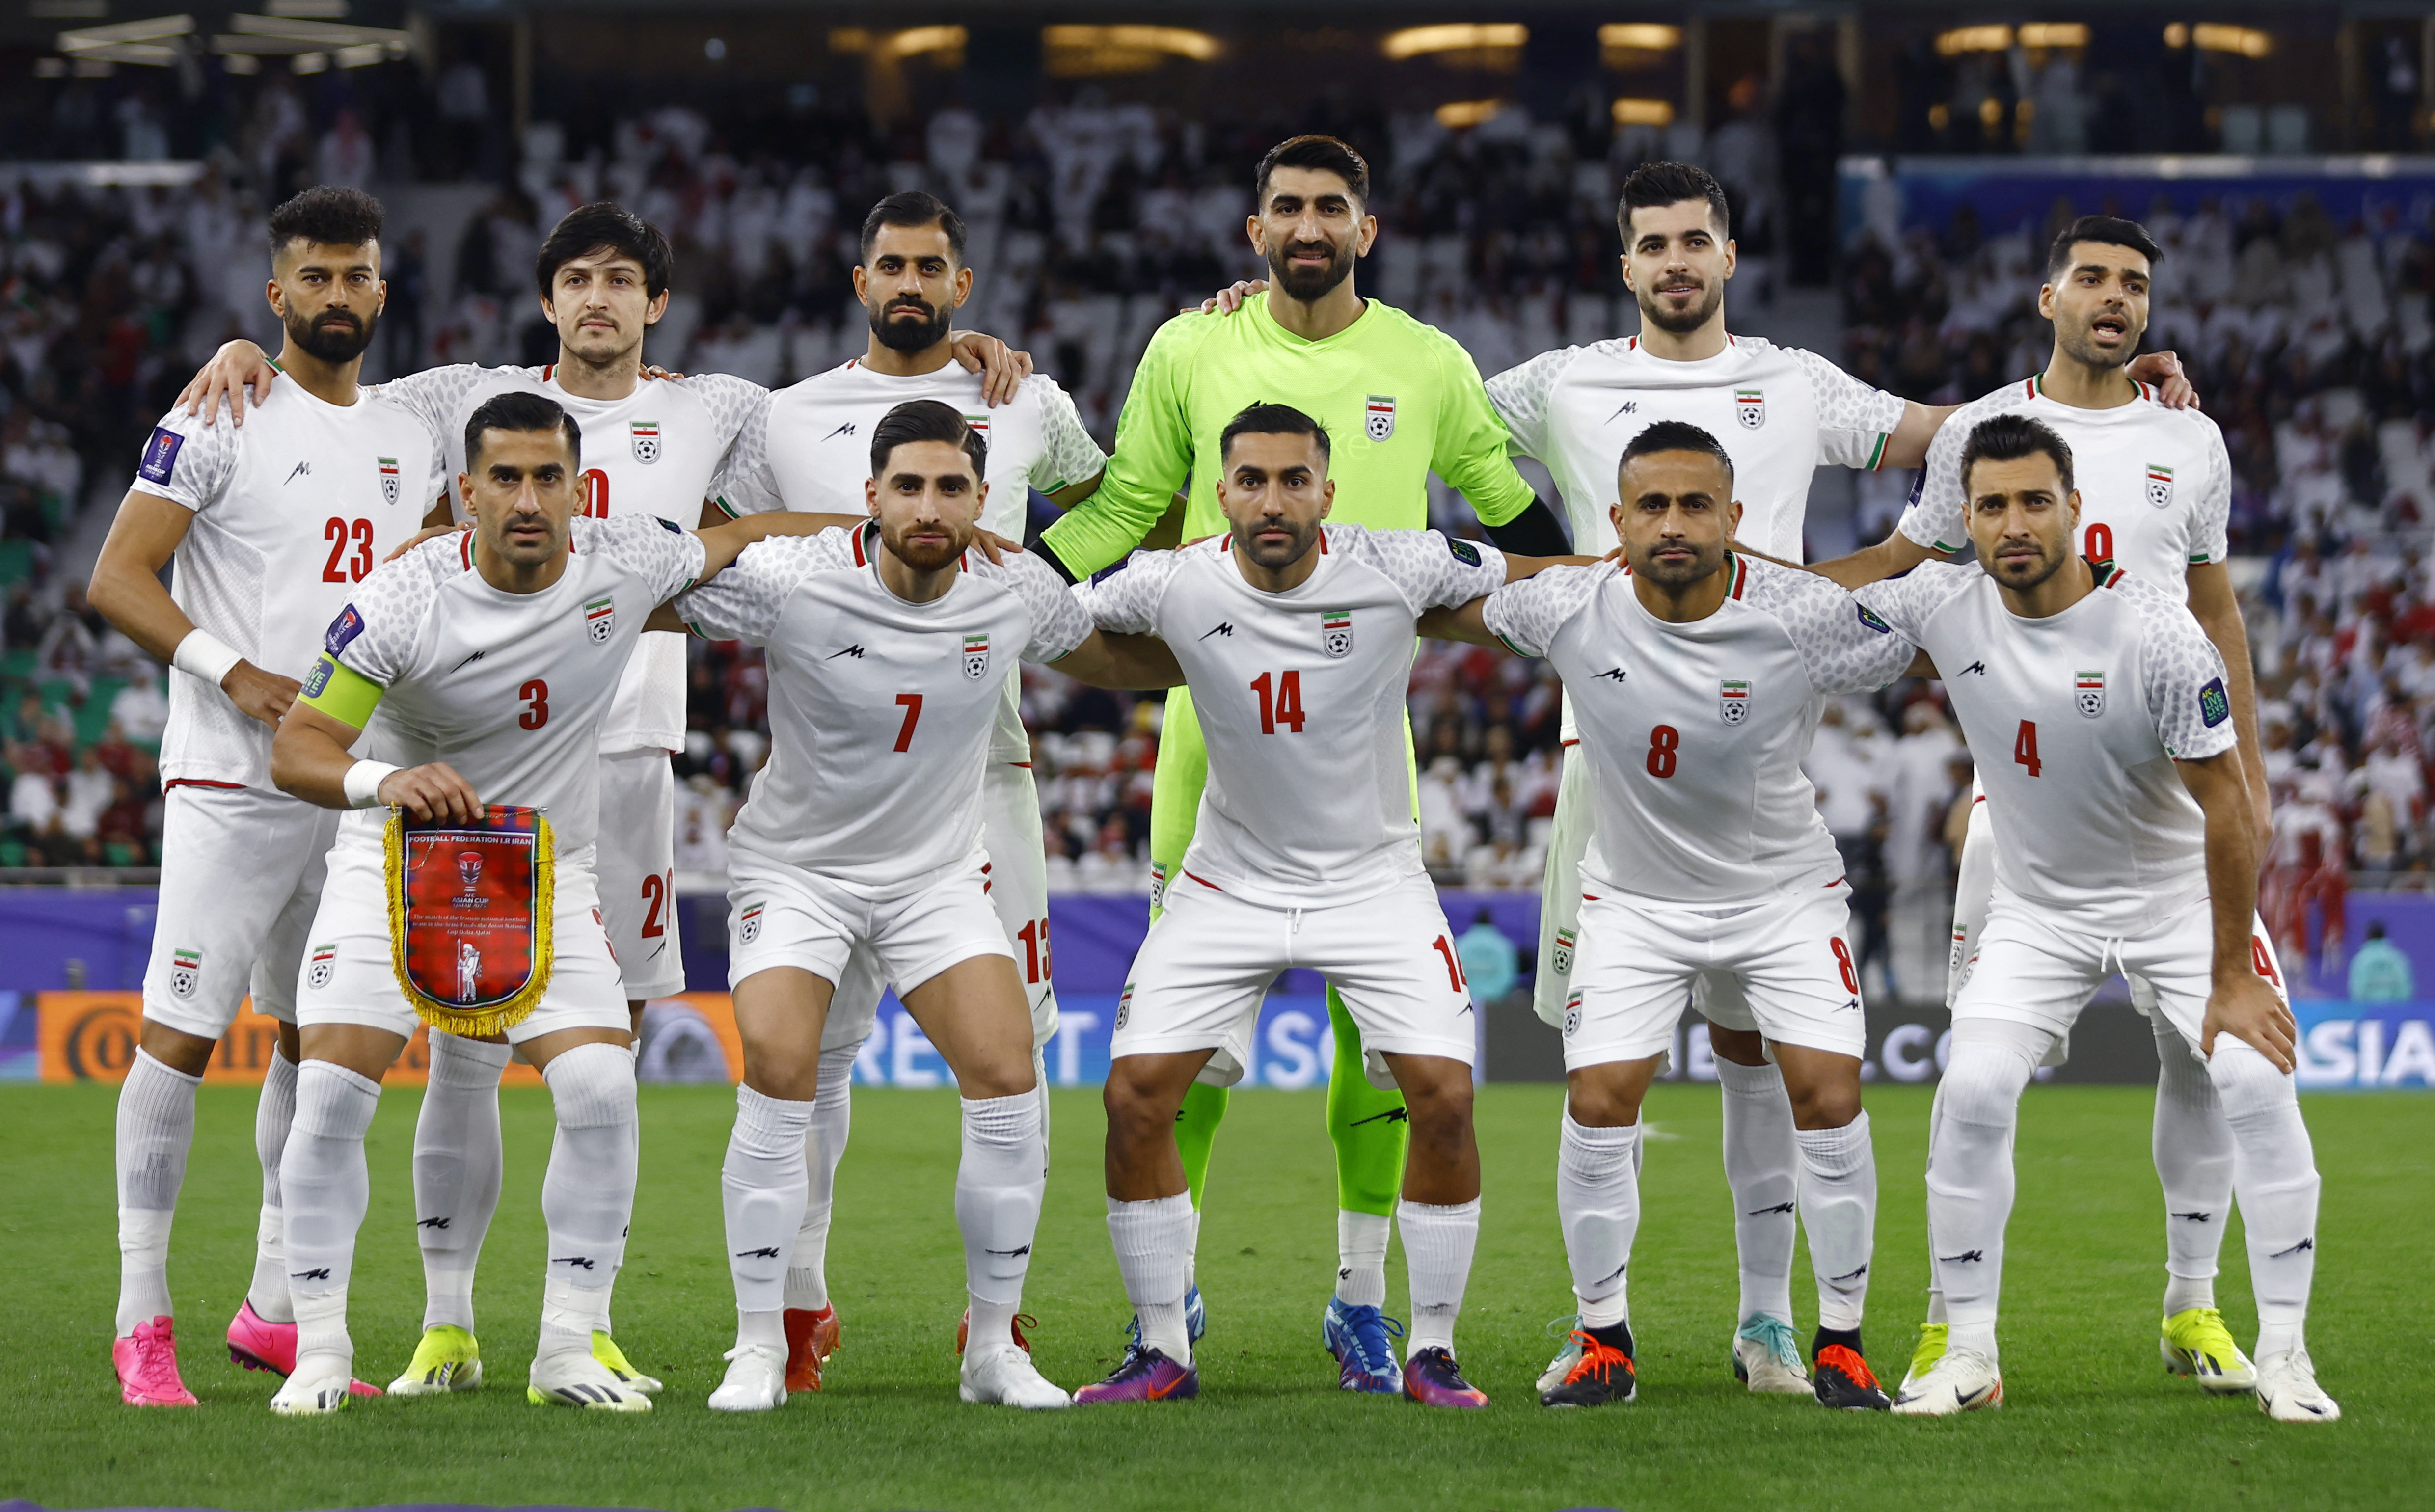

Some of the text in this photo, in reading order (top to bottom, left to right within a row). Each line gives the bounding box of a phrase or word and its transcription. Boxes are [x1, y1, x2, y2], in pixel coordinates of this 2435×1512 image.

[581, 468, 609, 519] 0
[322, 516, 374, 583] 23
[308, 668, 326, 684] IVE
[1250, 670, 1305, 734] 14
[2203, 690, 2223, 710] LIVE
[519, 679, 548, 730] 3
[893, 693, 923, 753] 7
[1647, 725, 1679, 778] 8
[2015, 719, 2041, 777] 4
[451, 835, 499, 843] FEDERATION
[1018, 917, 1052, 984] 13
[1830, 936, 1859, 995] 8
[2251, 934, 2280, 988] 4
